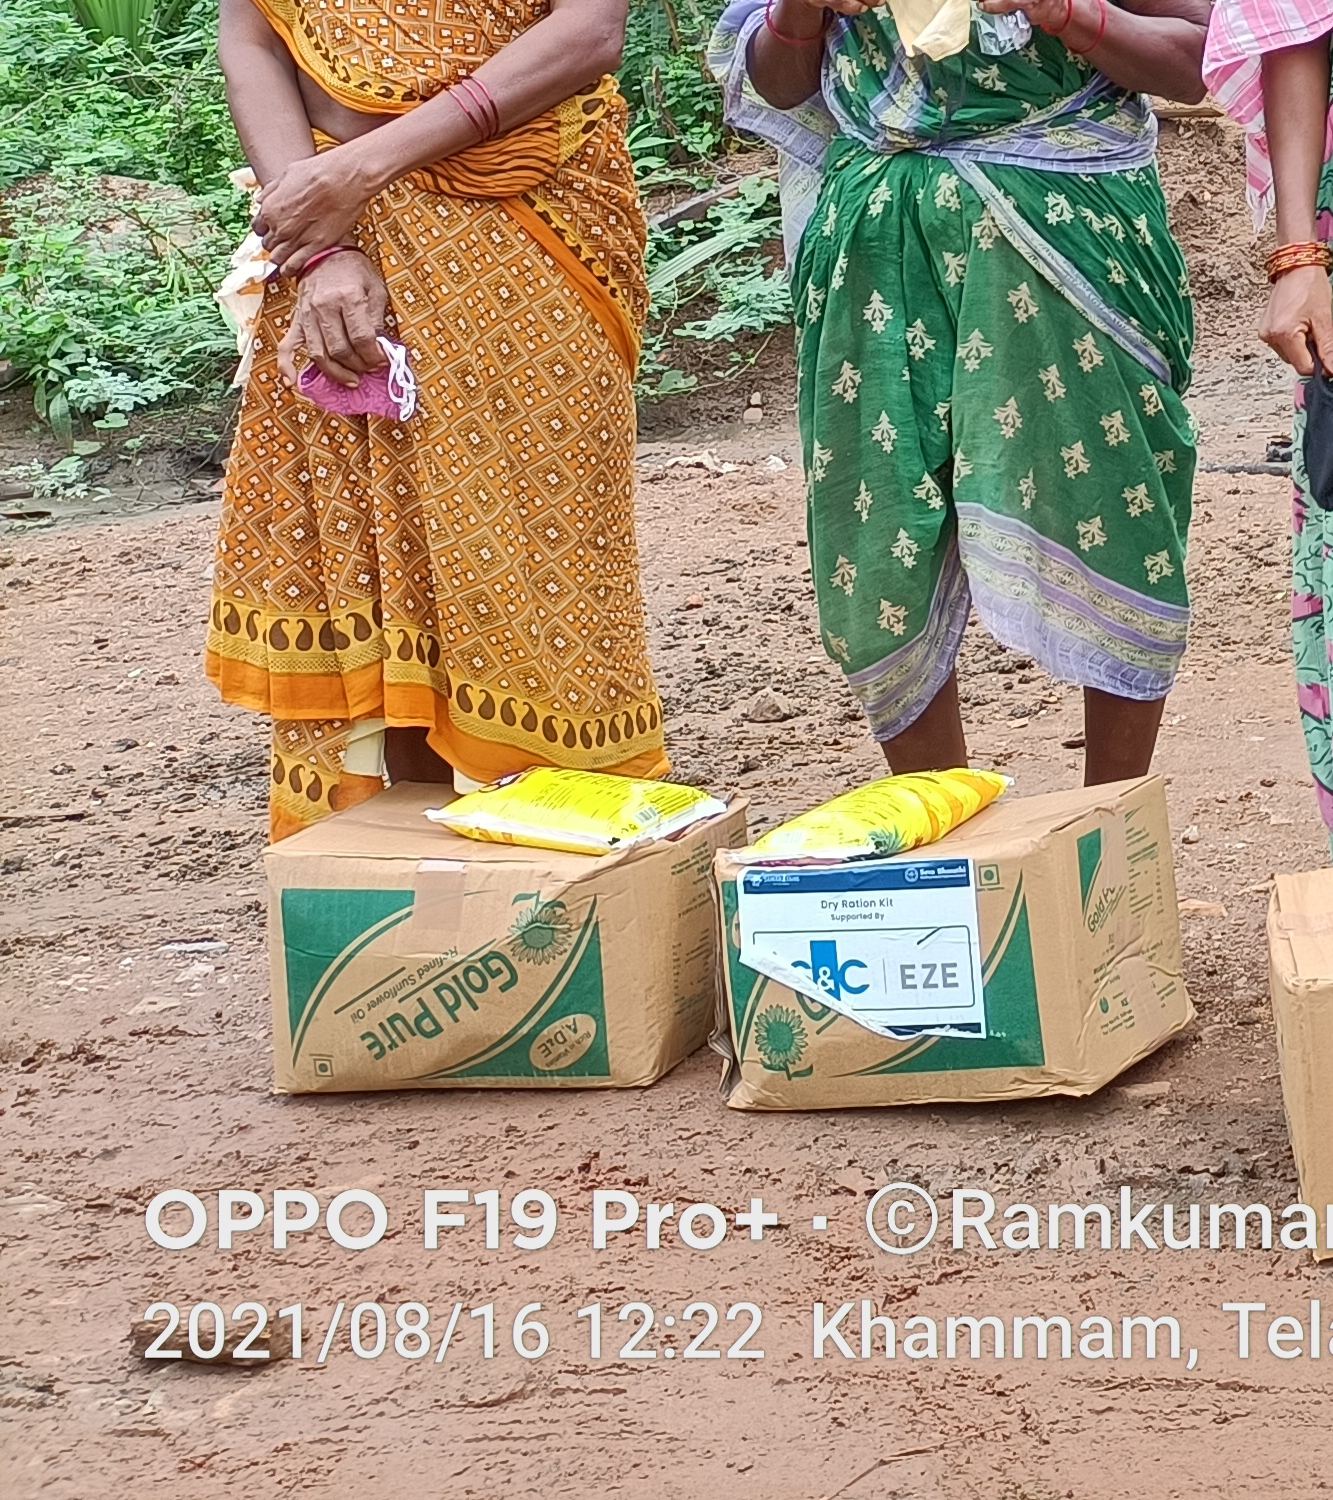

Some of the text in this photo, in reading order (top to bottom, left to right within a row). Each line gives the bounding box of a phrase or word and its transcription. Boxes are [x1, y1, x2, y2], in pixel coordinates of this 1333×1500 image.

[820, 897, 894, 911] Dry Ration Kit
[350, 945, 460, 1025] Refined Sunflower Oil
[899, 962, 960, 990] EZE
[359, 950, 519, 1061] Gold Pure
